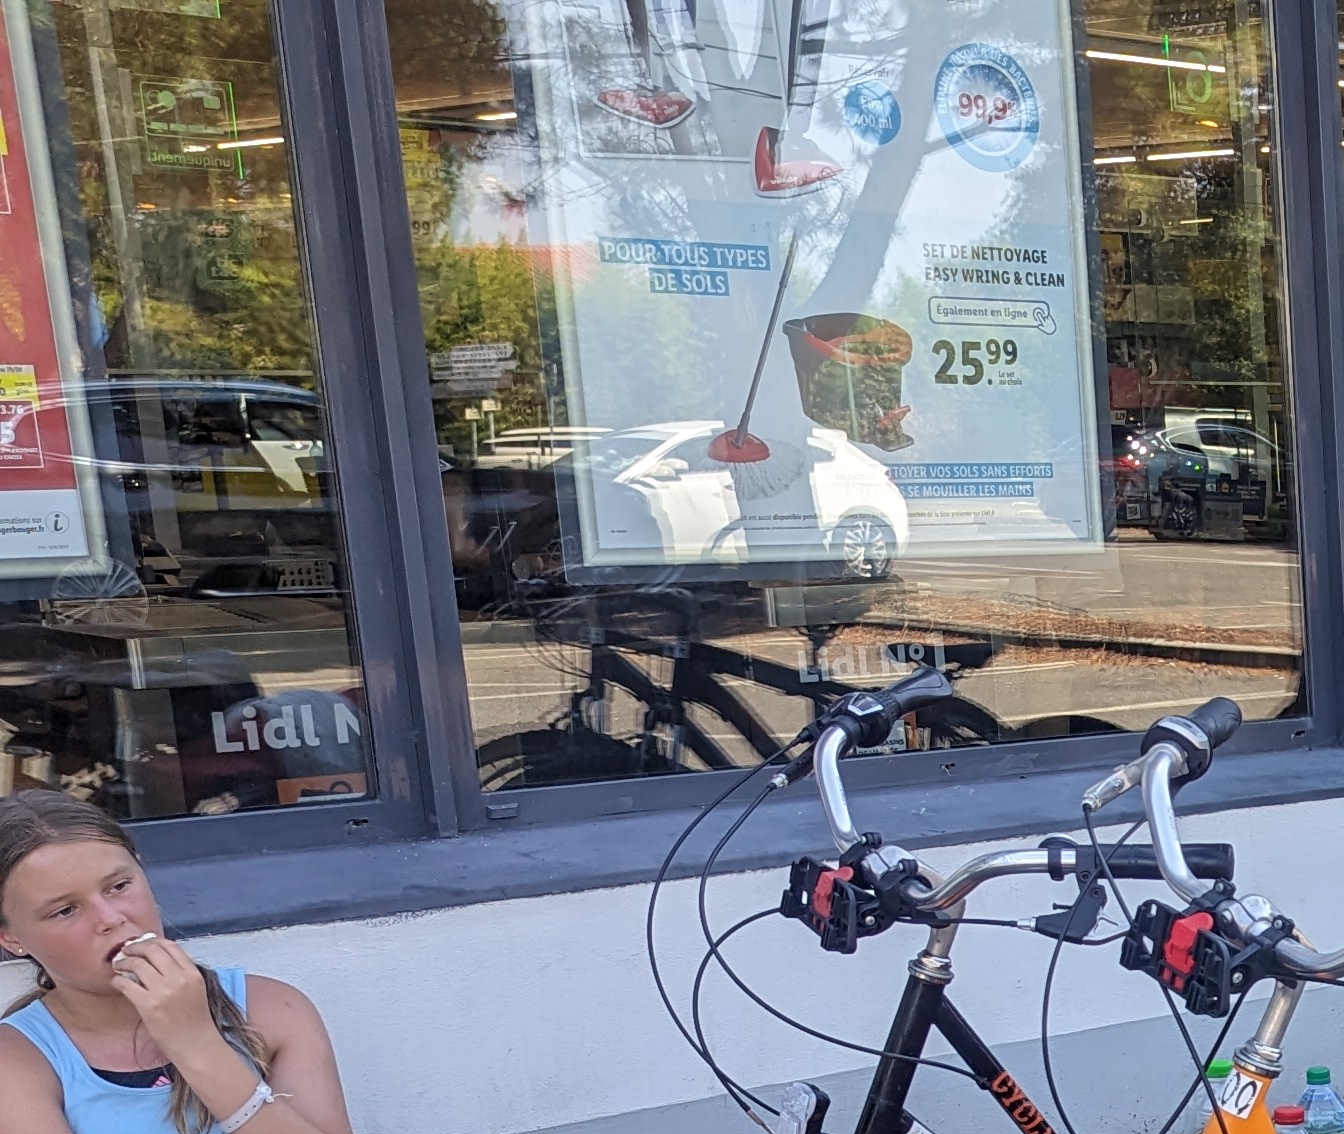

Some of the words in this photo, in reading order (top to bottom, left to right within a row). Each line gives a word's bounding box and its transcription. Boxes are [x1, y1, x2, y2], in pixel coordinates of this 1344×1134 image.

[602, 241, 657, 263] POUR
[661, 244, 710, 266] TOUS
[713, 248, 767, 268] TYPES
[922, 243, 946, 259] SET
[950, 244, 968, 260] DE
[971, 246, 1048, 264] NETTOYAGE
[653, 272, 677, 292] DE
[682, 274, 726, 294] SOLS
[925, 267, 958, 282] EASY
[962, 268, 1010, 285] WRING
[1013, 272, 1023, 286] &
[1025, 272, 1065, 287] CLEAN
[936, 303, 989, 319] Également
[990, 309, 1002, 318] en
[1004, 307, 1028, 320] ligne
[929, 466, 951, 478] VOS
[953, 466, 979, 478] SOLS
[981, 466, 1008, 478] SANS
[1010, 465, 1052, 477] EFFORTS
[908, 485, 920, 497] SE
[922, 484, 977, 497] MOUILLER
[979, 484, 996, 497] LES
[999, 484, 1033, 496] MAINS
[797, 645, 871, 684] Lidl
[211, 703, 321, 754] Lidl
